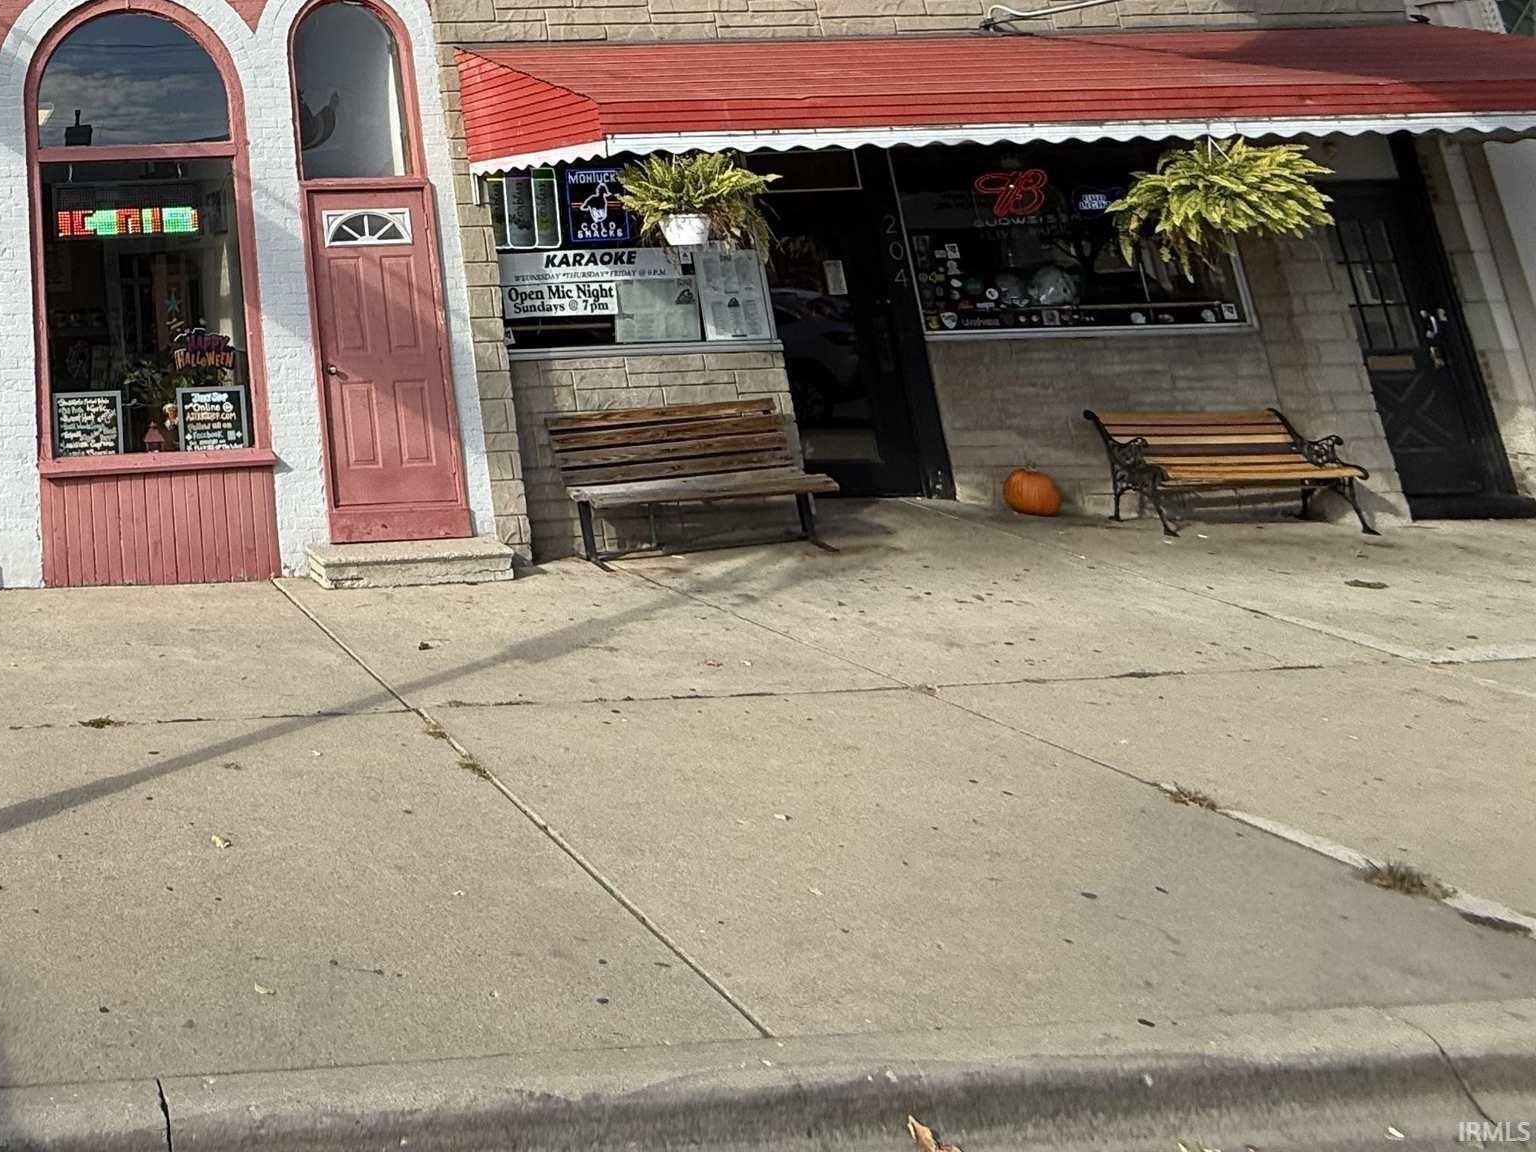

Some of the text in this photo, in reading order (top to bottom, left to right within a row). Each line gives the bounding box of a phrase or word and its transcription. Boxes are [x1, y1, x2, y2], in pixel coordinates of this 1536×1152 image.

[568, 170, 622, 185] MONTUCK
[577, 228, 624, 239] SNACKS
[545, 250, 637, 269] KARAOKE
[507, 283, 614, 305] Open Mic Night
[513, 298, 609, 314] Sundays @ 7pm
